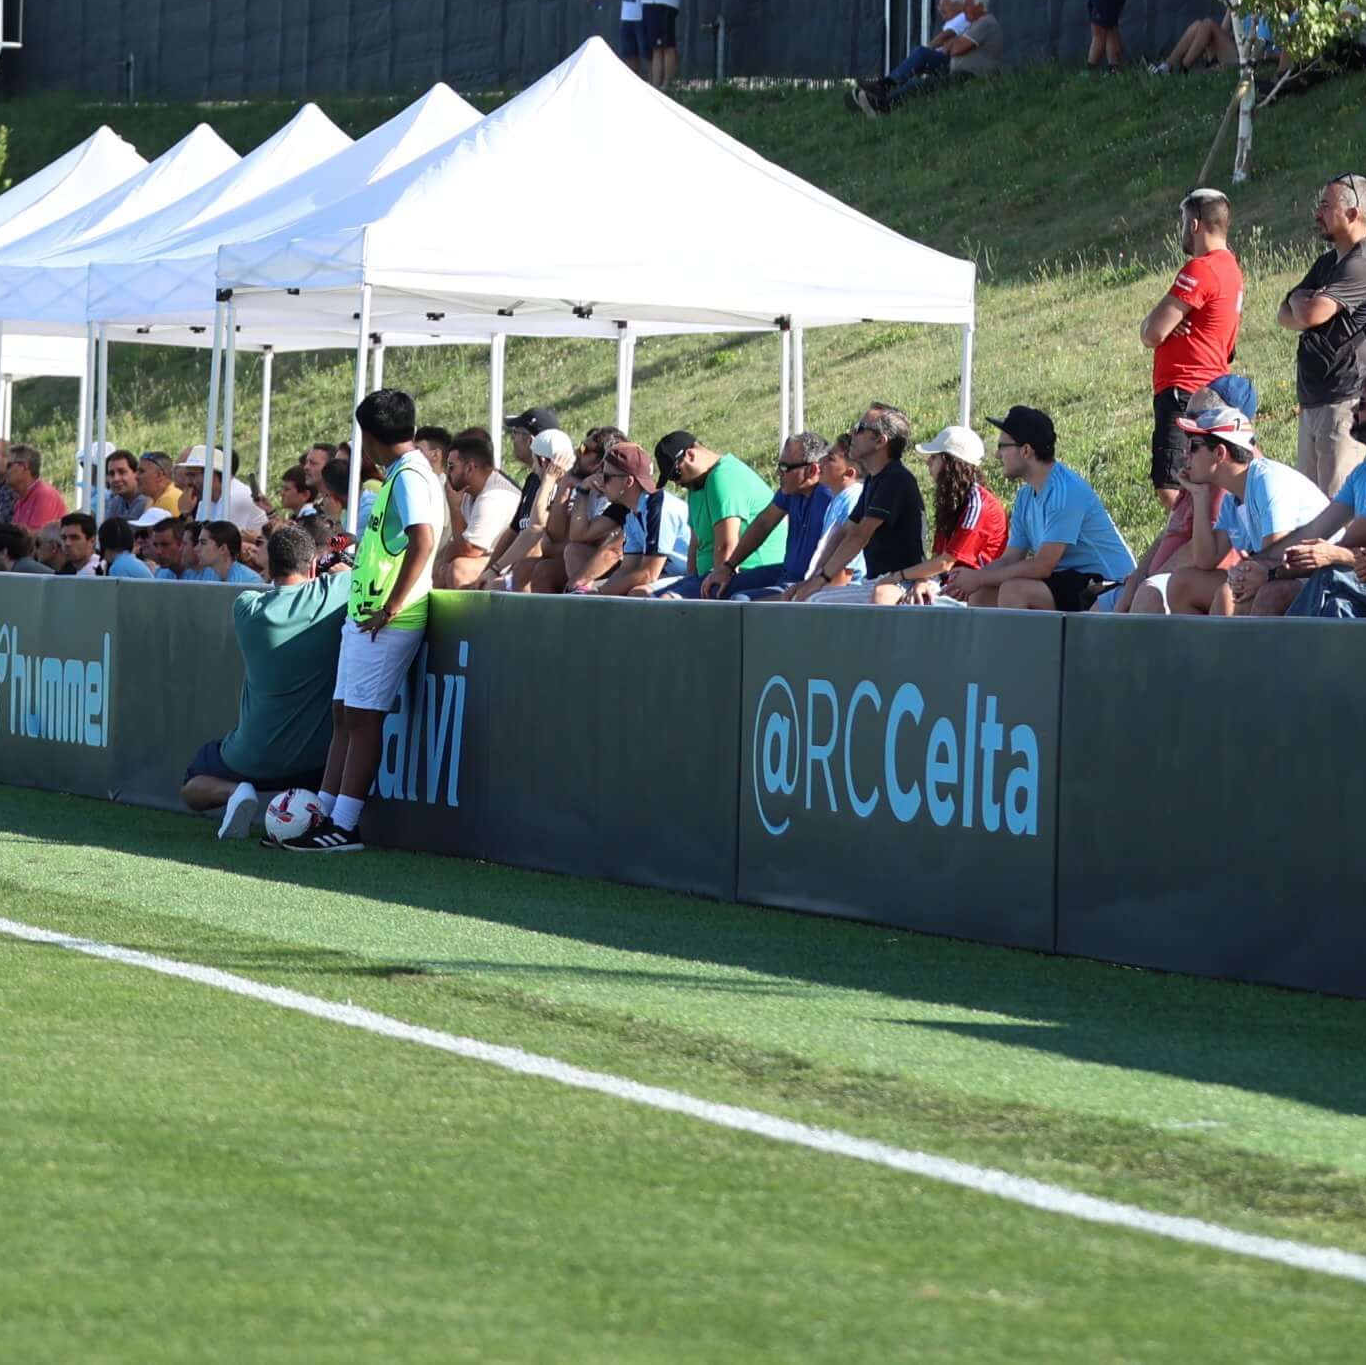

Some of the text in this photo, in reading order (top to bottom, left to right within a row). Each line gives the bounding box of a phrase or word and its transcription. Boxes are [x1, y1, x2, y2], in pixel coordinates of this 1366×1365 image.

[9, 625, 110, 748] hummel
[369, 640, 469, 807] alvi
[753, 675, 1039, 835] @RCCelta
